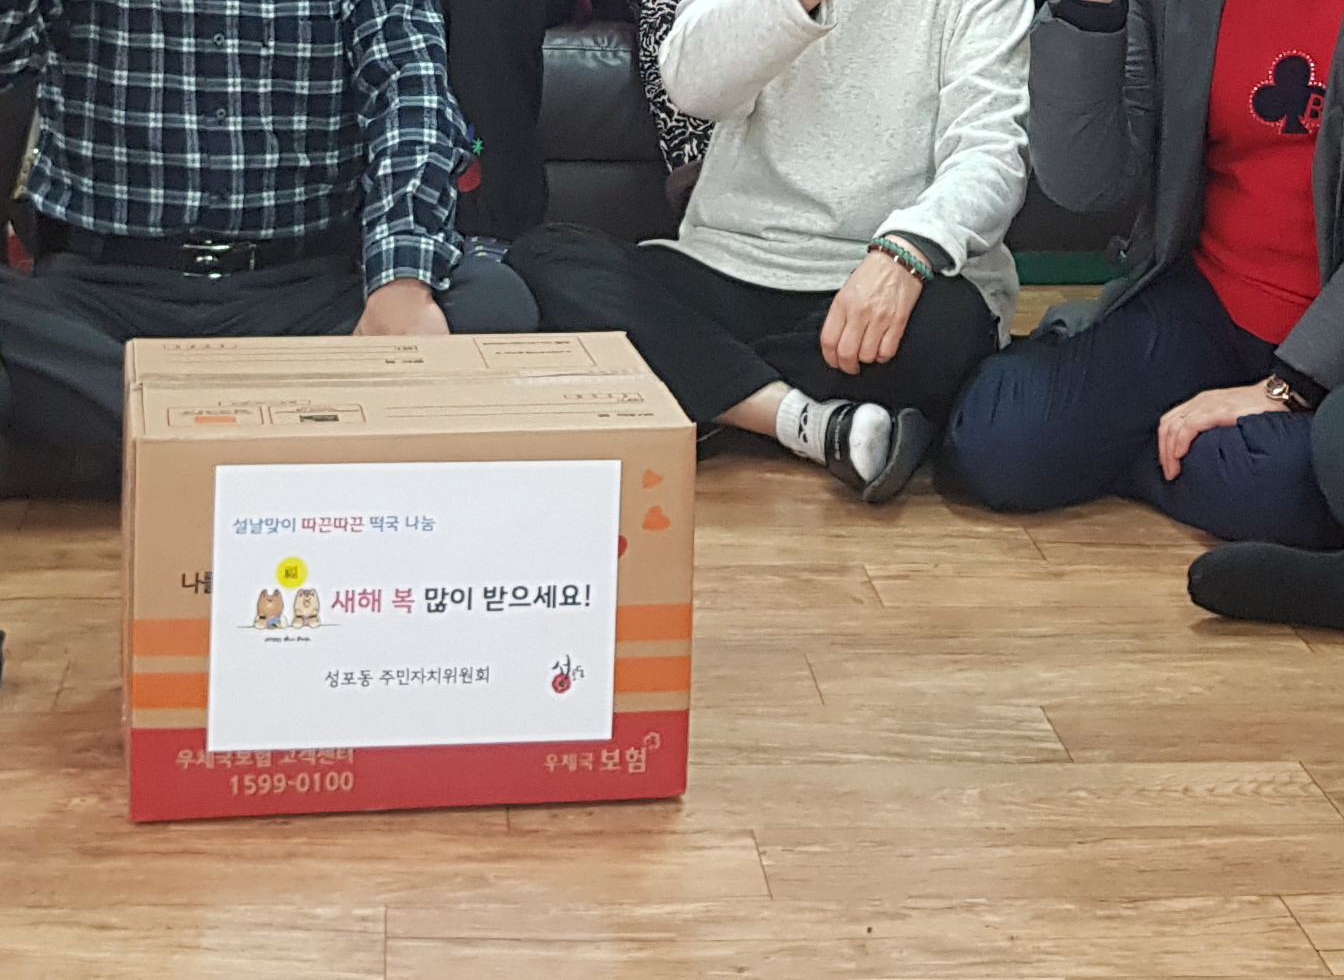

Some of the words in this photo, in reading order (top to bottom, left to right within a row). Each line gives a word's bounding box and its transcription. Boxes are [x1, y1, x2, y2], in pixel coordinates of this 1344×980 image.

[233, 516, 296, 535] 설날맞이
[301, 516, 364, 534] 따끈따끈
[369, 515, 400, 532] 떡국
[405, 514, 436, 532] 나눔
[331, 588, 383, 614] 새해
[392, 588, 416, 614] 복
[425, 586, 474, 614] 많이
[483, 584, 592, 613] 받으세요!
[325, 669, 374, 688] 성포동
[379, 665, 491, 686] 주민자치위원회
[542, 751, 594, 773] 우체국
[598, 746, 648, 774] 보험
[229, 771, 355, 797] 1599-0100
